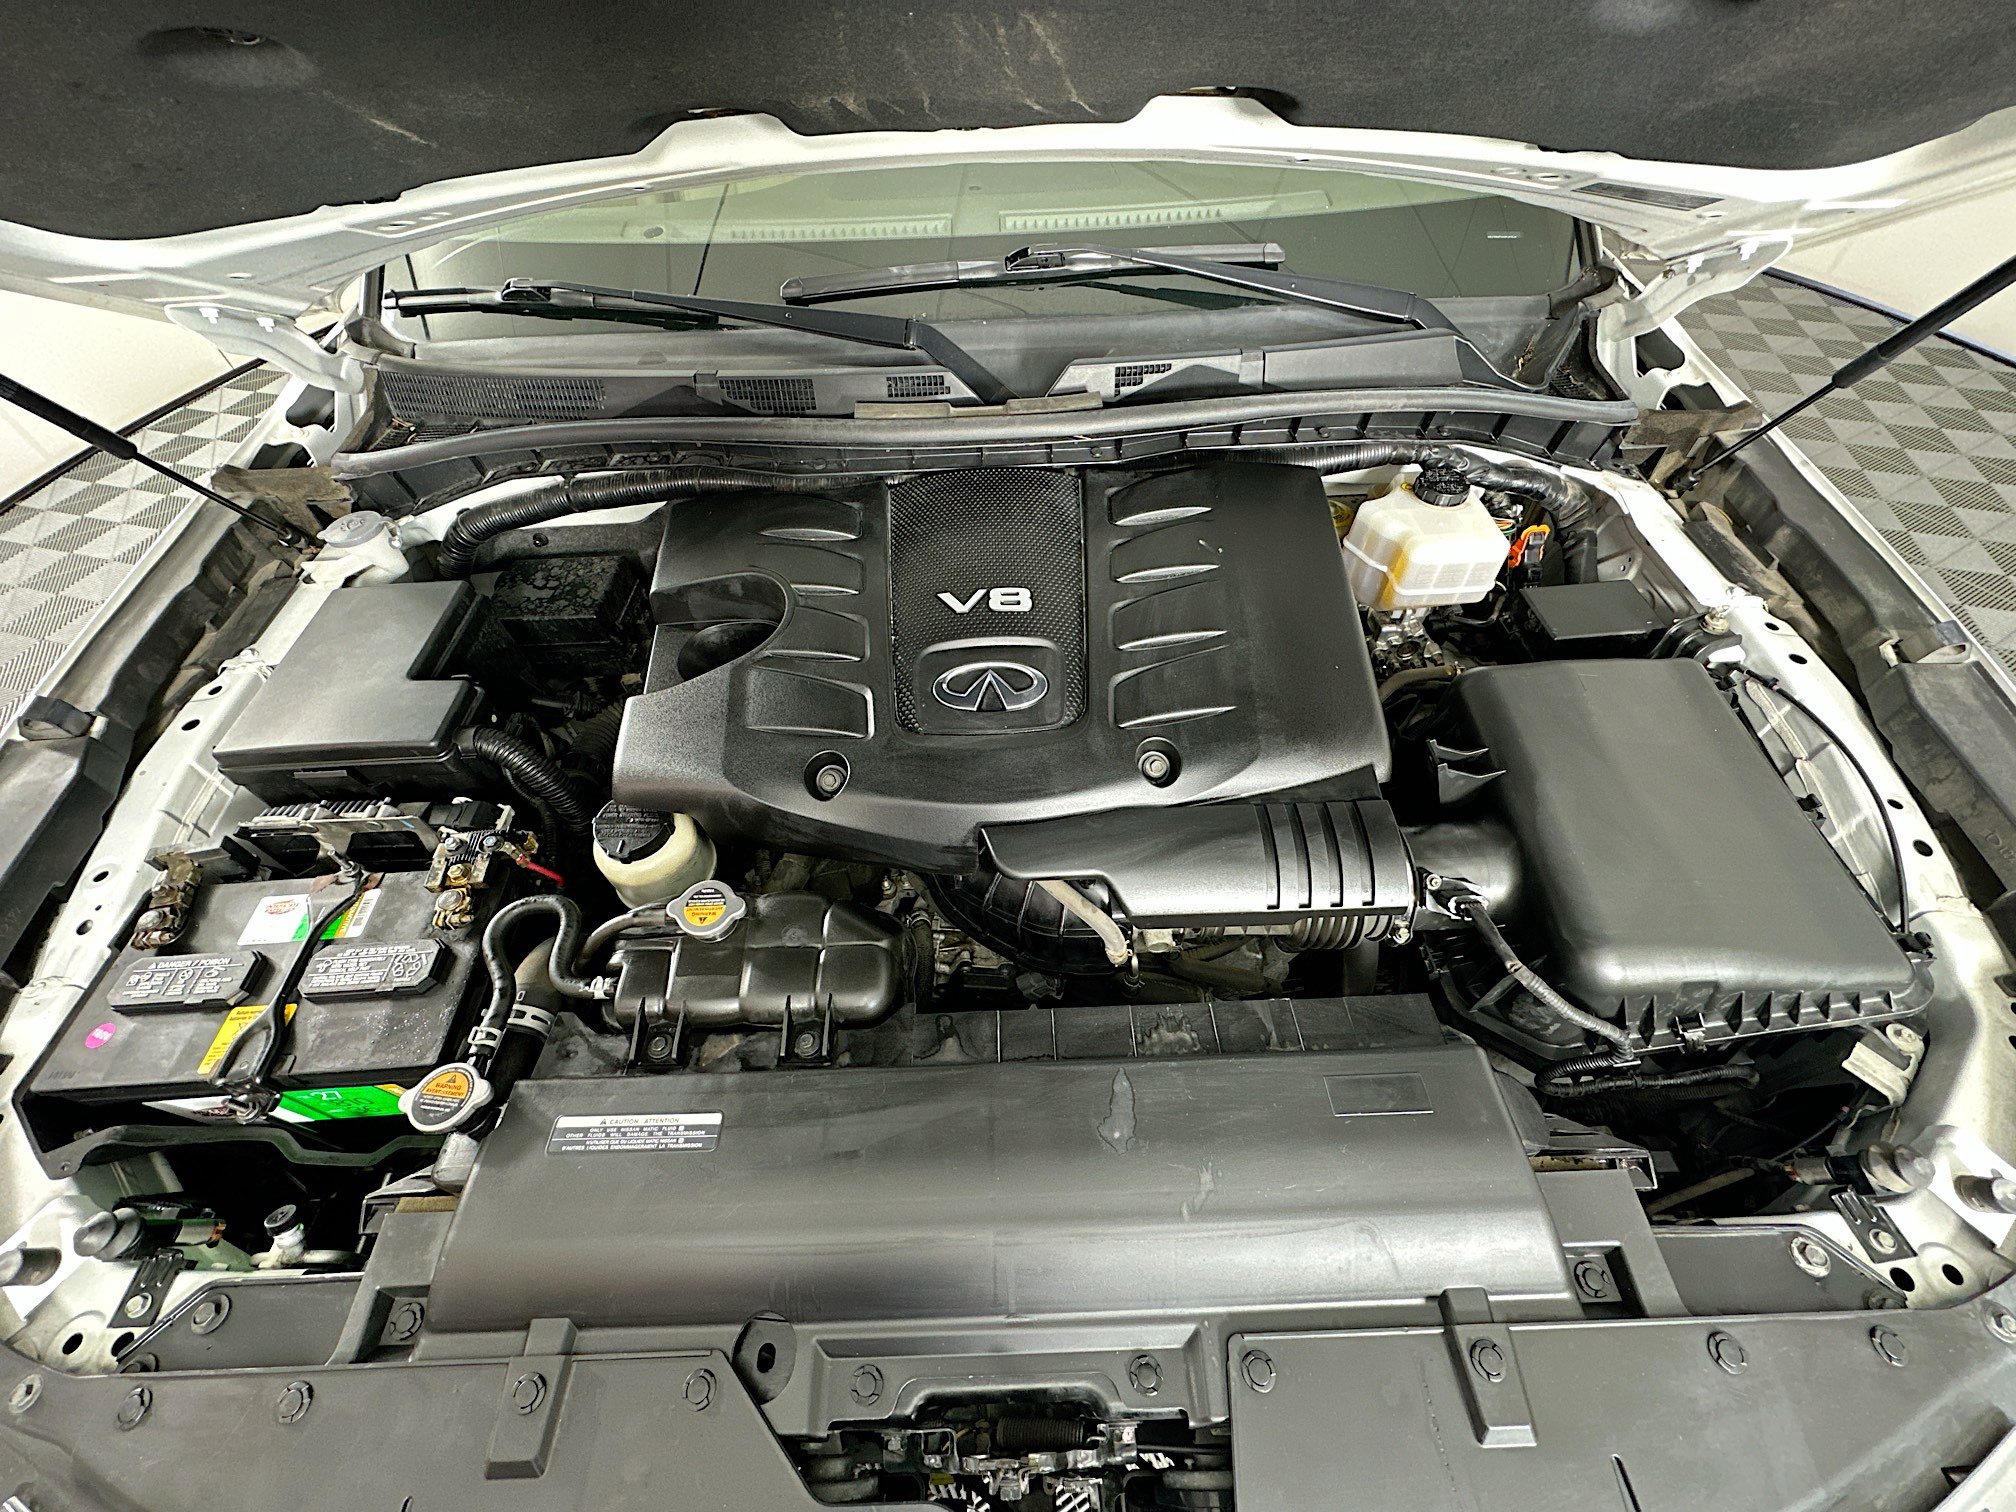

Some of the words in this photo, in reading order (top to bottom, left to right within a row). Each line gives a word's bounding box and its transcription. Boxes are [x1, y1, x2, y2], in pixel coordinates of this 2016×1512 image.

[937, 587, 1033, 614] V8
[157, 960, 193, 969] DANGER
[199, 957, 231, 966] POISON
